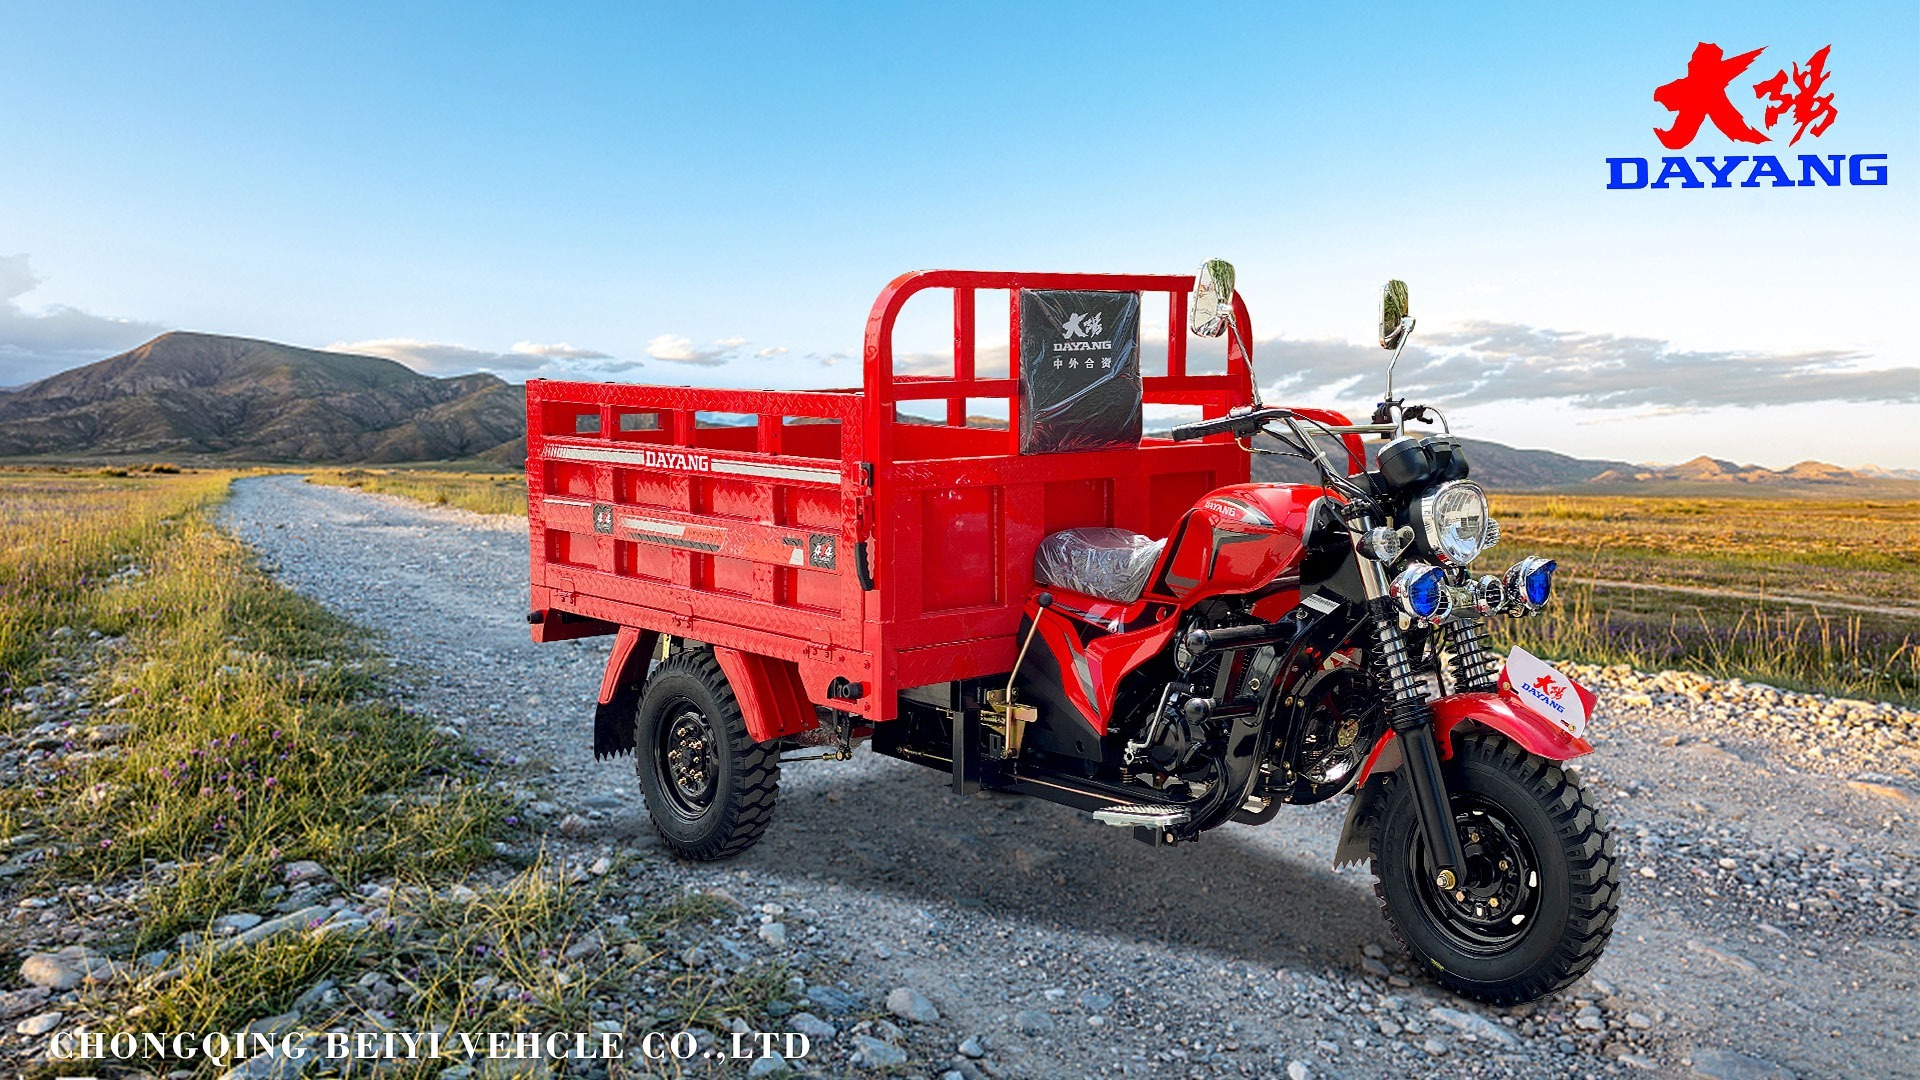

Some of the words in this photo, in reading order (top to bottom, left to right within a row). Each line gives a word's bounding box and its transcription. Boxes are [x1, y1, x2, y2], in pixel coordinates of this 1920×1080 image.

[1053, 341, 1112, 352] DAYANG
[1053, 357, 1112, 369] 中外合资
[644, 450, 709, 472] DAYANG
[1204, 501, 1236, 517] DAYANG
[1521, 683, 1565, 713] DAYANG
